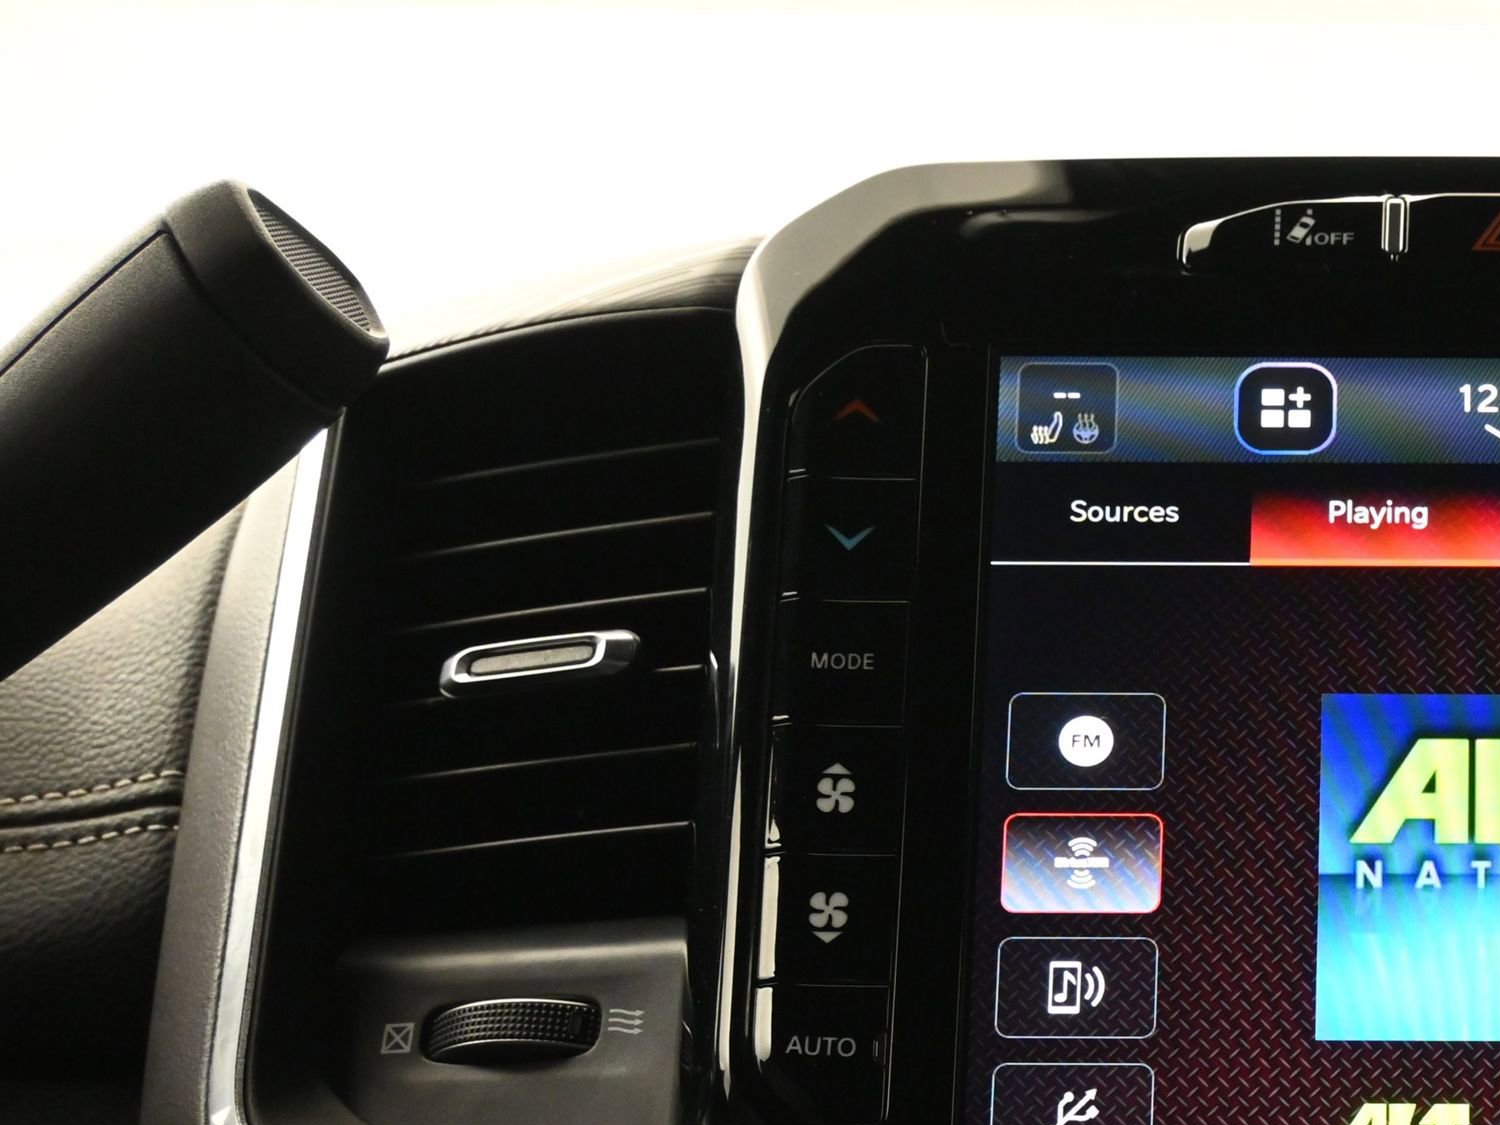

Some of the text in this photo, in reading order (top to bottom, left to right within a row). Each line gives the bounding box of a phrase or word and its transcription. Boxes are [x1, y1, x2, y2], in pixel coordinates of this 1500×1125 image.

[1313, 232, 1354, 246] OFF
[1069, 499, 1180, 523] Sources
[1327, 499, 1429, 530] Playing
[810, 651, 874, 670] MODE
[1071, 732, 1102, 750] FM
[785, 1035, 857, 1058] AUTO
